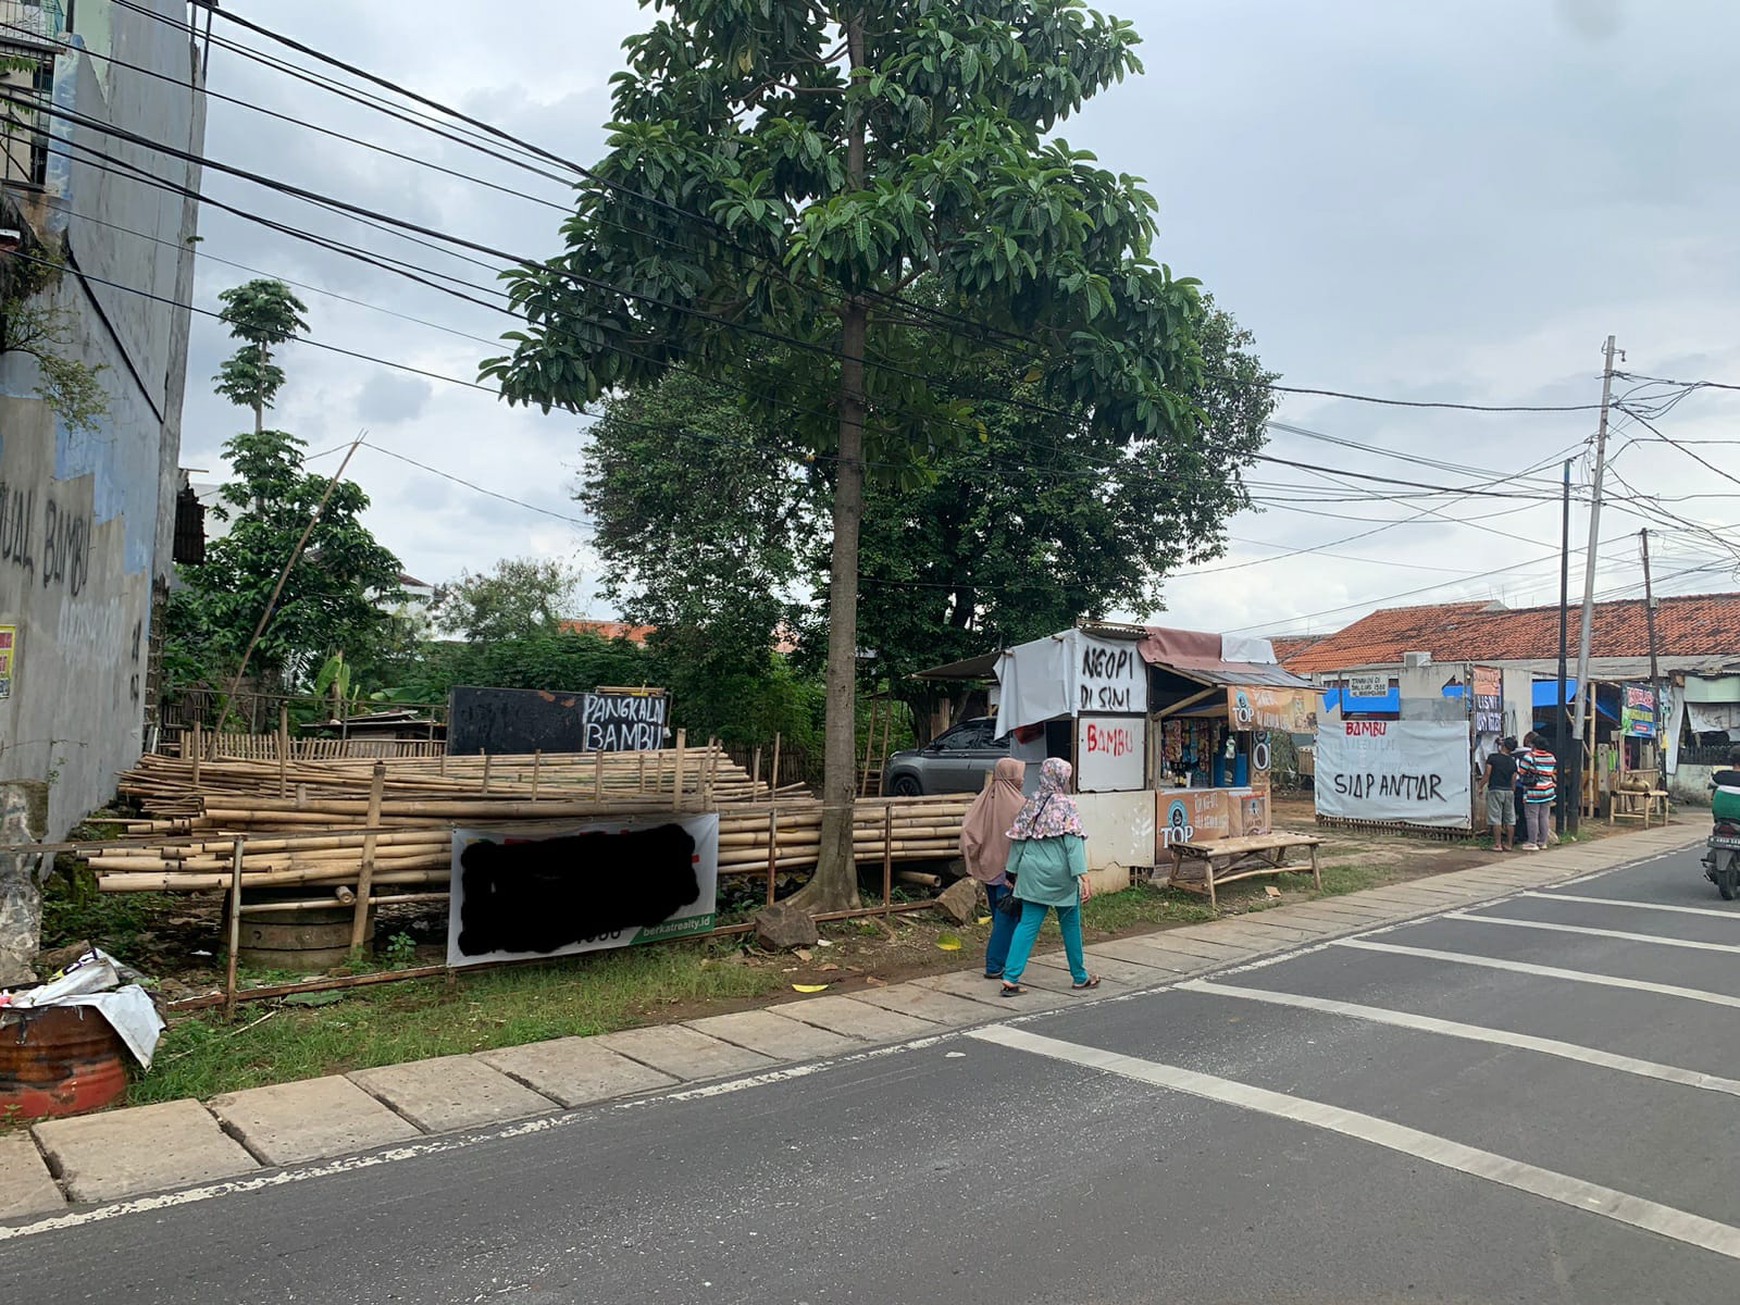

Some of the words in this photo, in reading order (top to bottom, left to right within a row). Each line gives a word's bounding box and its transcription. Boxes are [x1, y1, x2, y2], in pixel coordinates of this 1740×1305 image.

[43, 498, 91, 597] BAMBU
[1083, 645, 1133, 680] NGOPI
[1080, 685, 1093, 709] DI
[1098, 686, 1131, 711] SINI
[1232, 707, 1255, 723] TOP
[586, 723, 661, 752] BAMBU
[1087, 724, 1134, 757] BAMBU
[1346, 722, 1387, 738] BAMBU
[1334, 773, 1375, 799] SIAP
[1379, 773, 1447, 803] ANTAR
[1160, 825, 1194, 849] TOP
